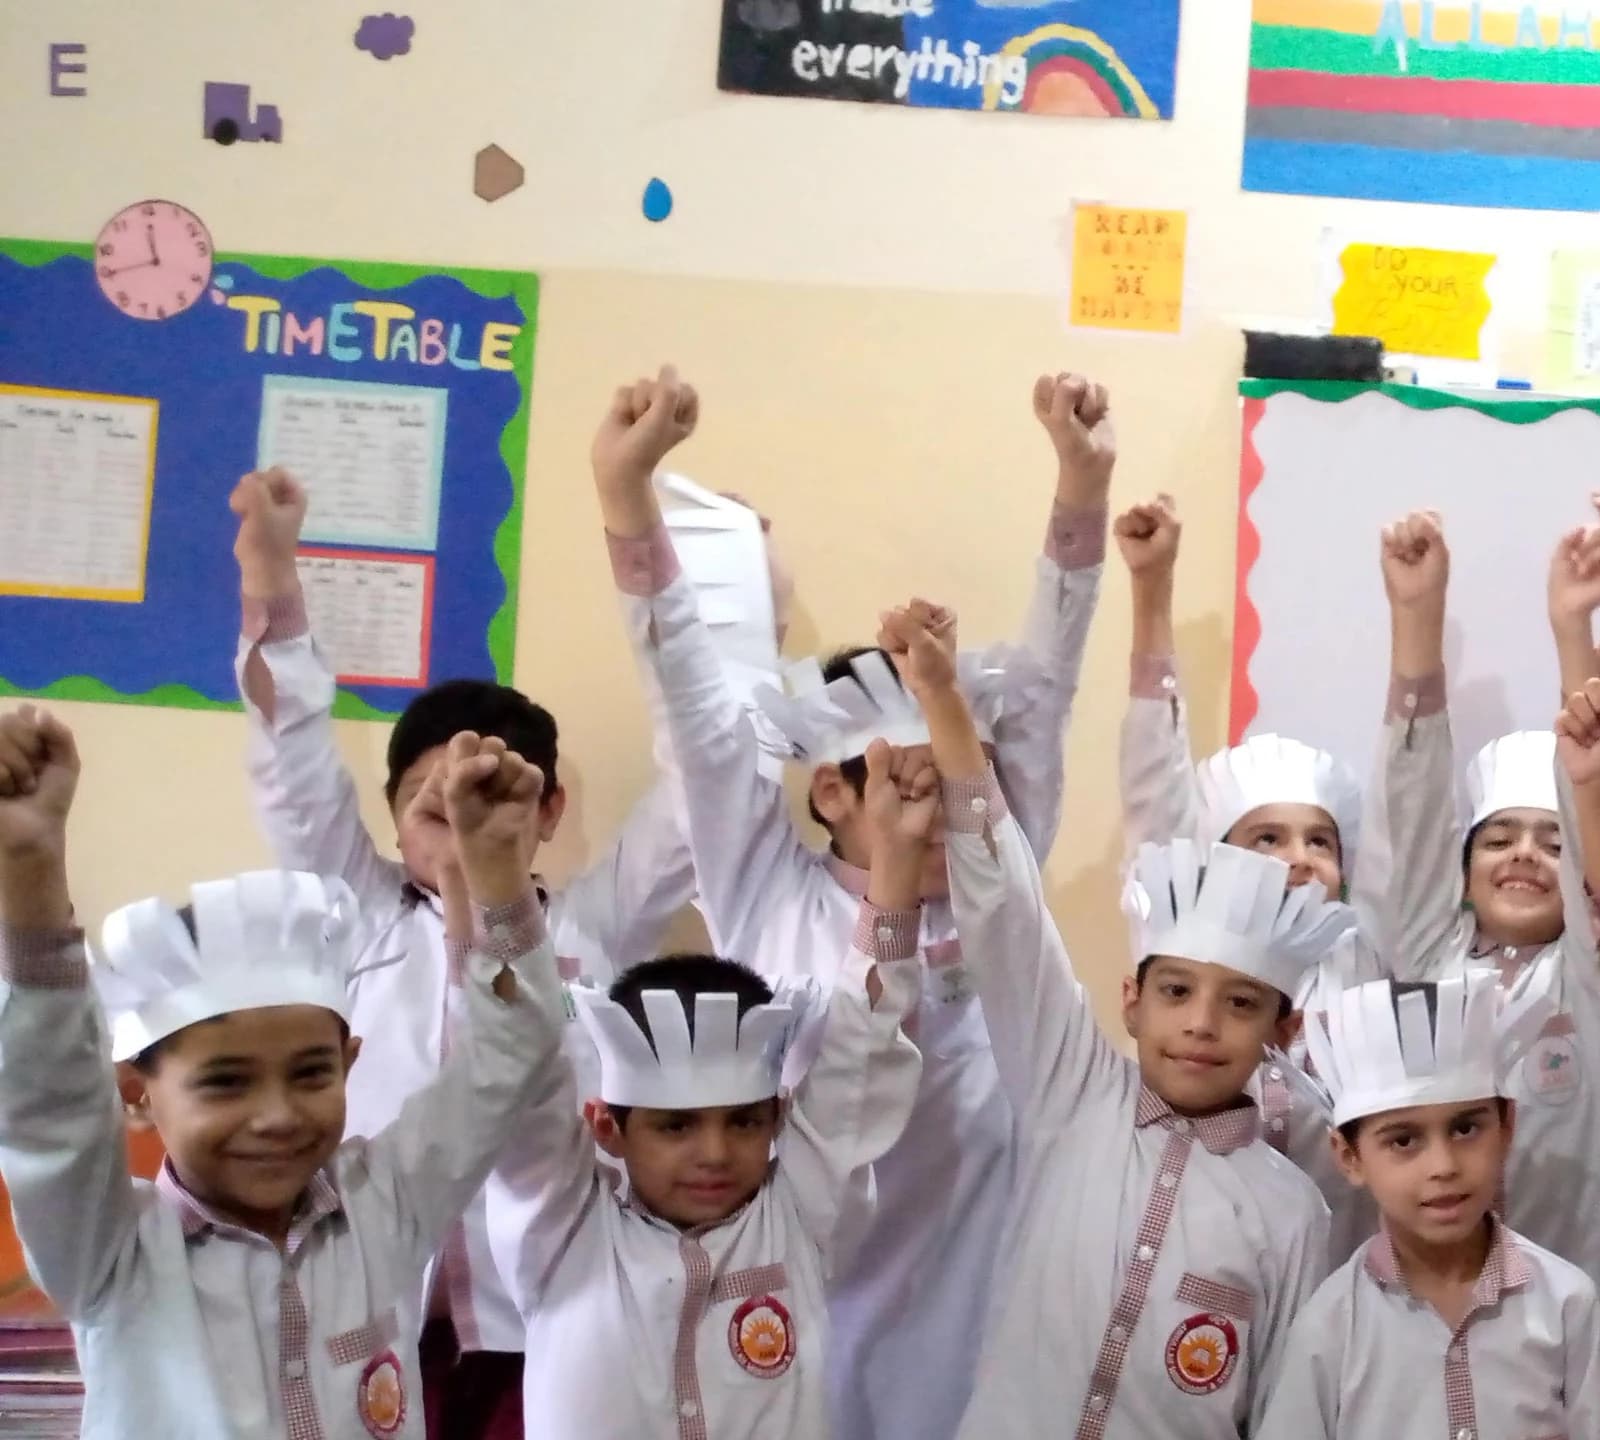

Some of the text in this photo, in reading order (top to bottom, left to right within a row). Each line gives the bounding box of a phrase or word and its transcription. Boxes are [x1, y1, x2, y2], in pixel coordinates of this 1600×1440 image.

[50, 43, 87, 97] E
[792, 39, 1028, 105] everything
[1392, 274, 1460, 302] YOUR
[227, 295, 522, 371] TIMETABLE
